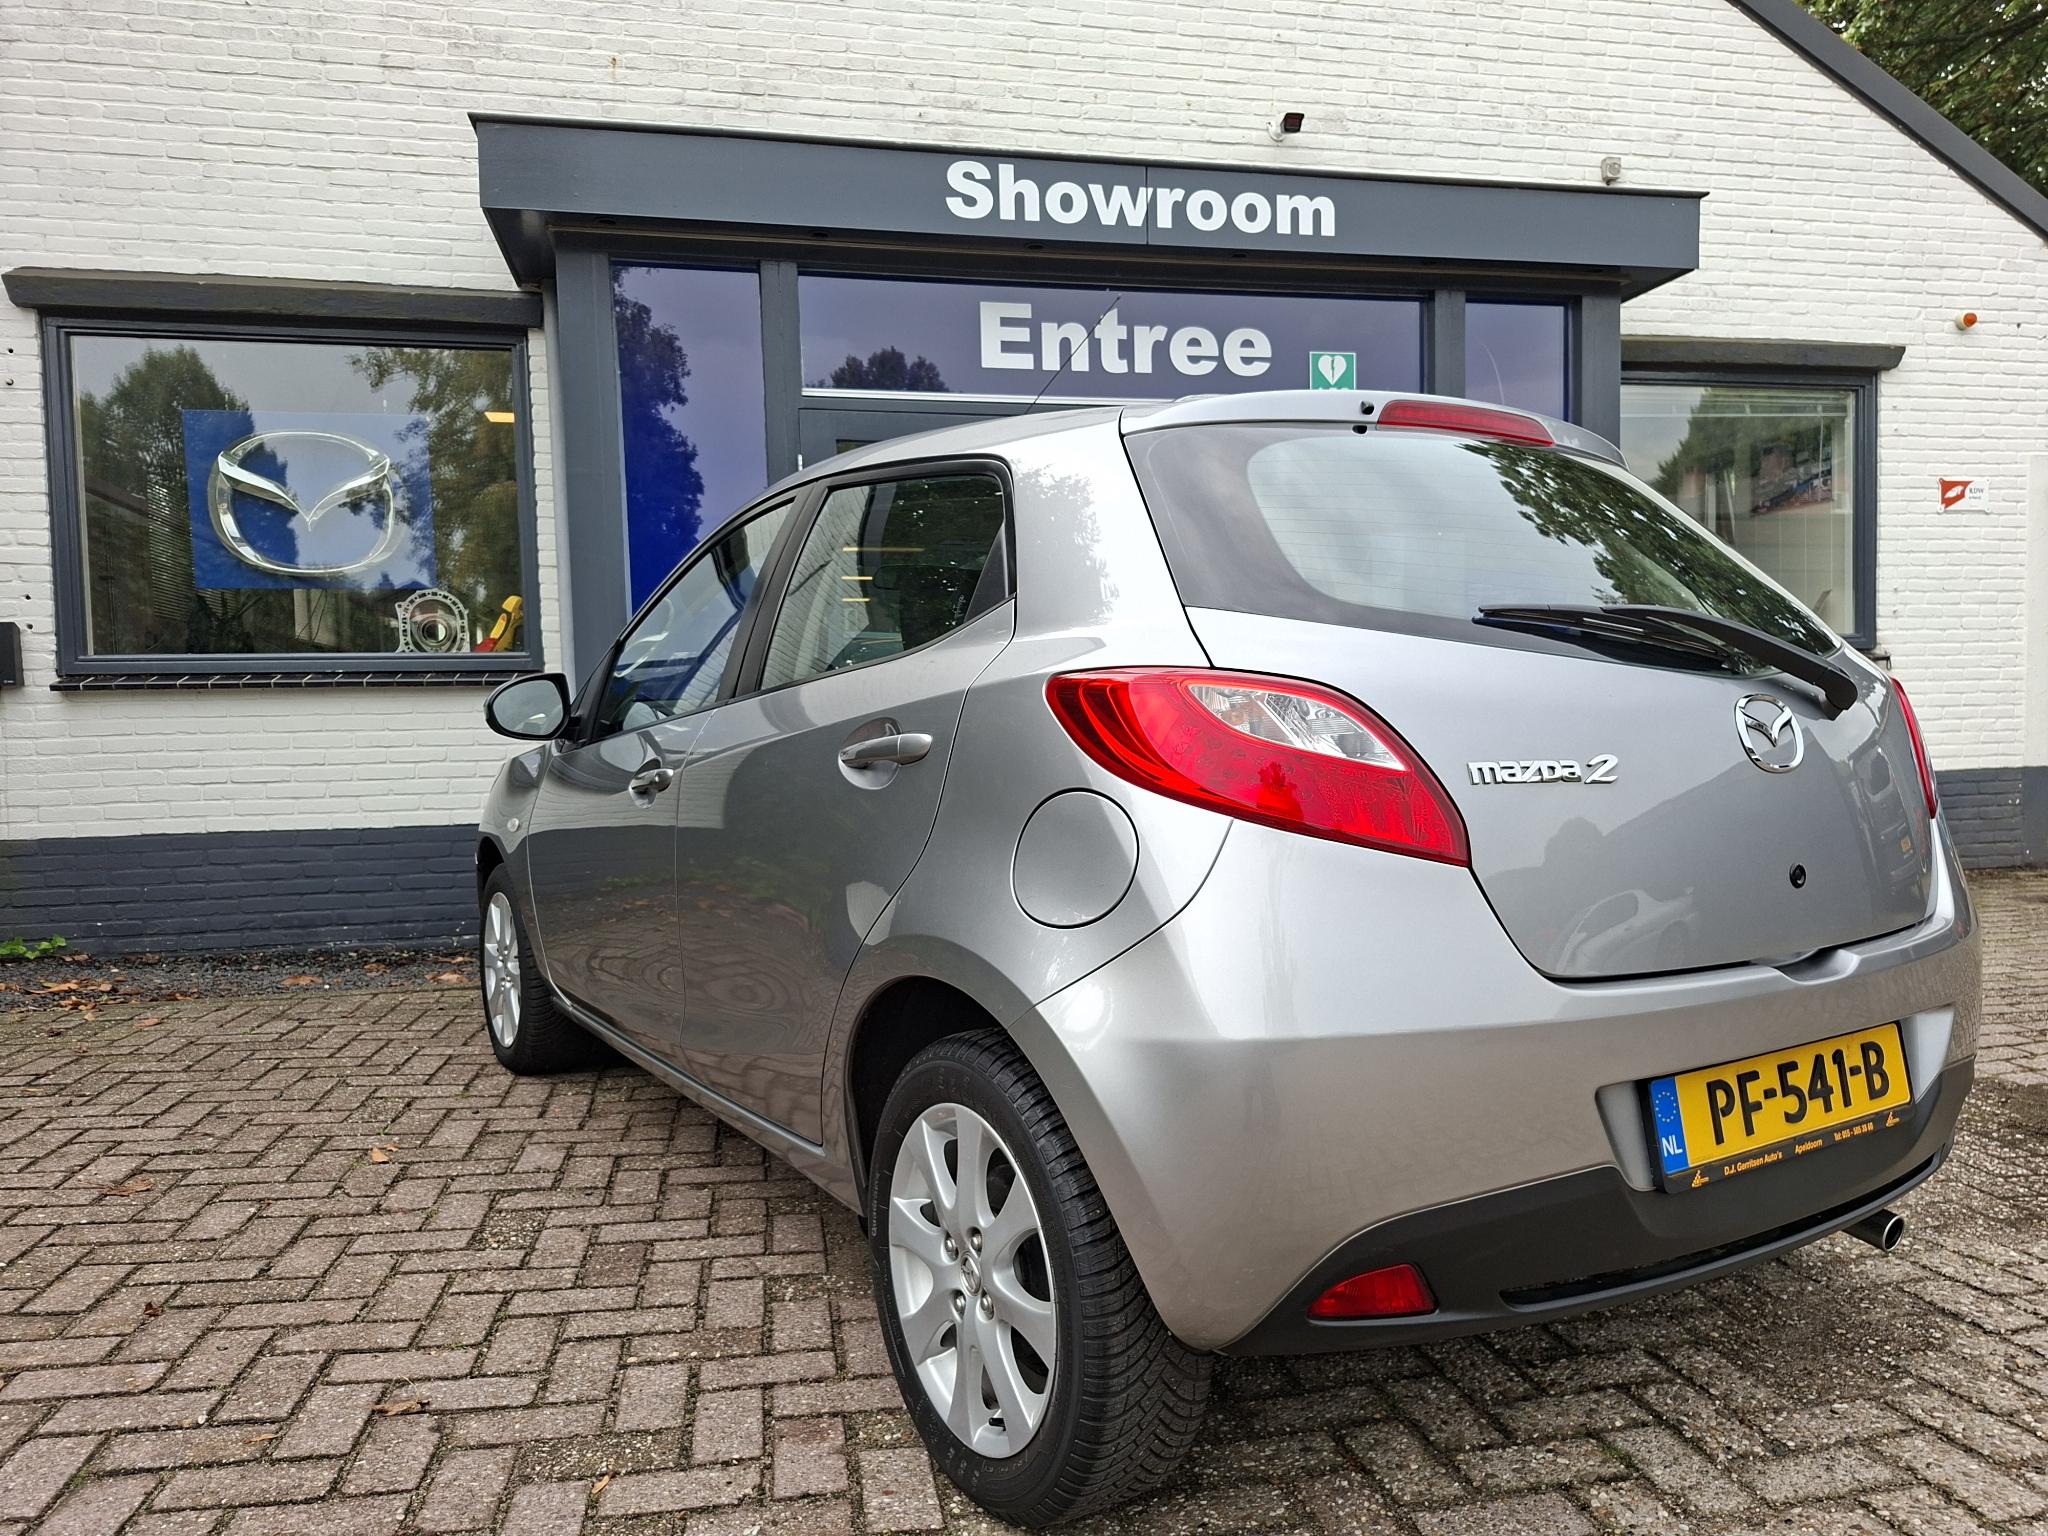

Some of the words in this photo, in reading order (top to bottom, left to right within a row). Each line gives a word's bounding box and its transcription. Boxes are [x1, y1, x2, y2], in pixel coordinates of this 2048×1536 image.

[945, 160, 1335, 237] Showroom
[979, 301, 1272, 377] Entree
[1706, 1040, 1890, 1146] PF-541-B
[1662, 1135, 1683, 1158] NL
